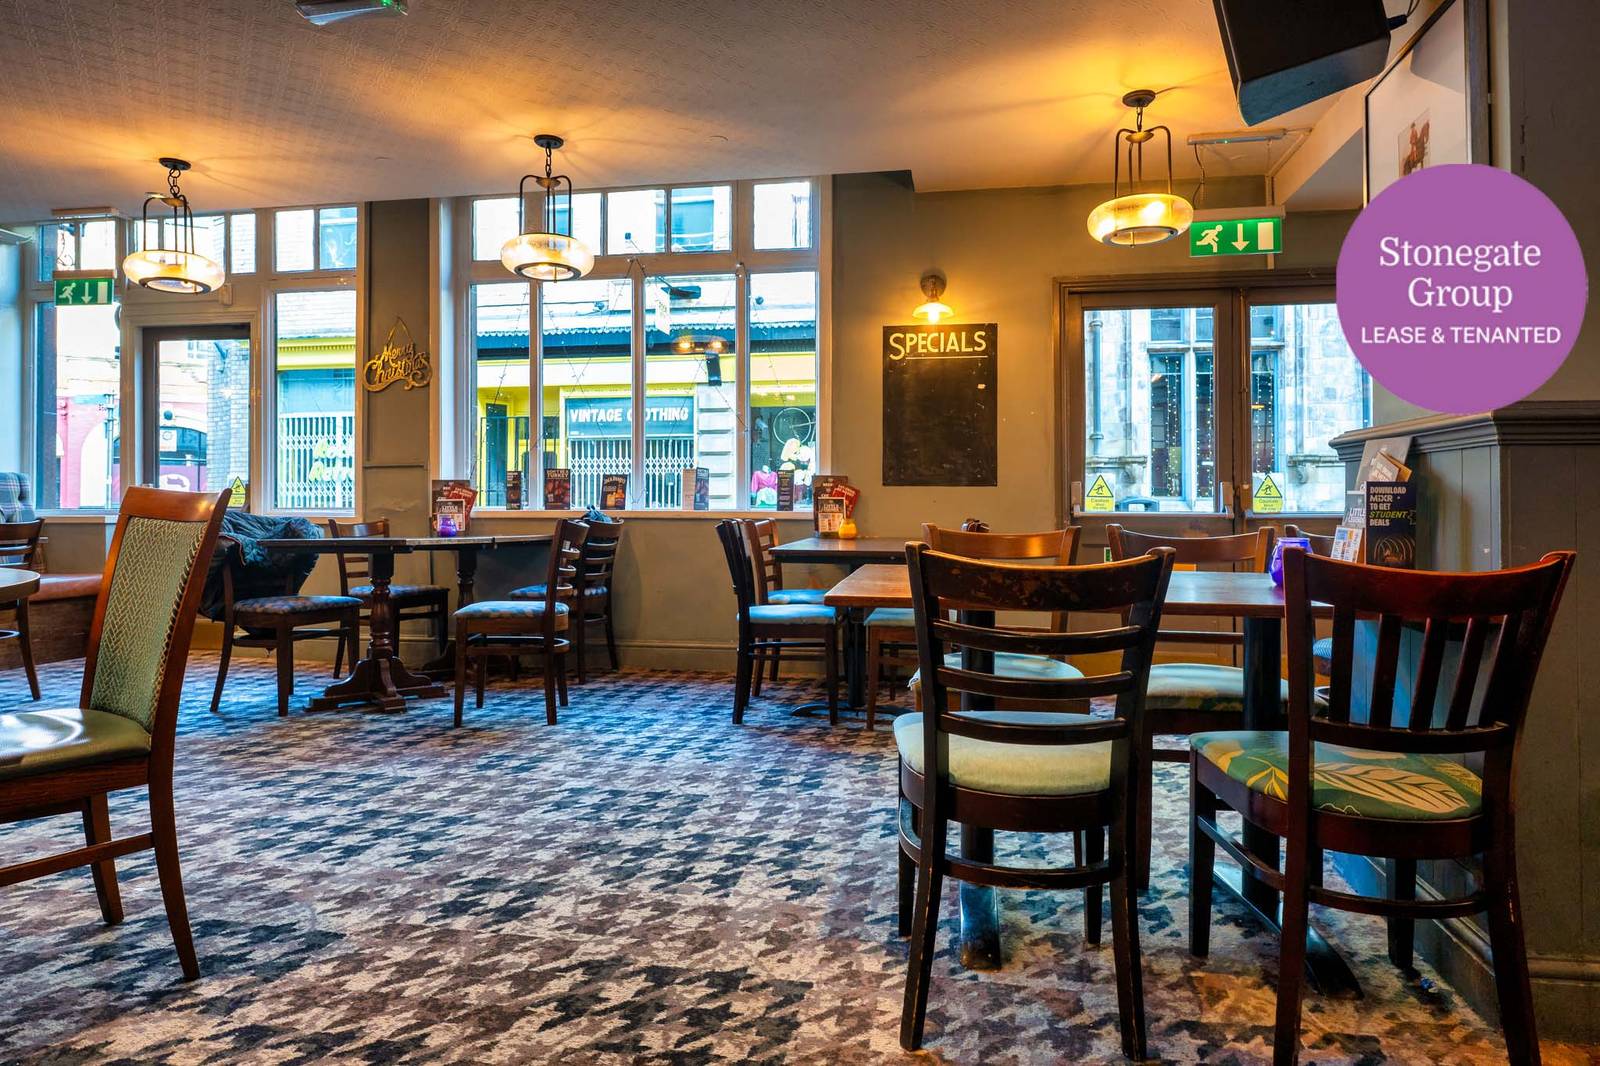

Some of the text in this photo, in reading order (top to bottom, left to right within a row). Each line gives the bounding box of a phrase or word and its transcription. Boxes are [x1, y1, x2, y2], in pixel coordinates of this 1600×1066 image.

[889, 330, 987, 360] SPECIALS
[380, 342, 415, 362] Merry
[569, 406, 689, 422] VINTAGE COTHING
[1369, 486, 1407, 494] DOWNLOAD
[1369, 503, 1392, 511] TO GET
[1369, 510, 1409, 519] STUDENT
[1369, 519, 1390, 527] DEALS
